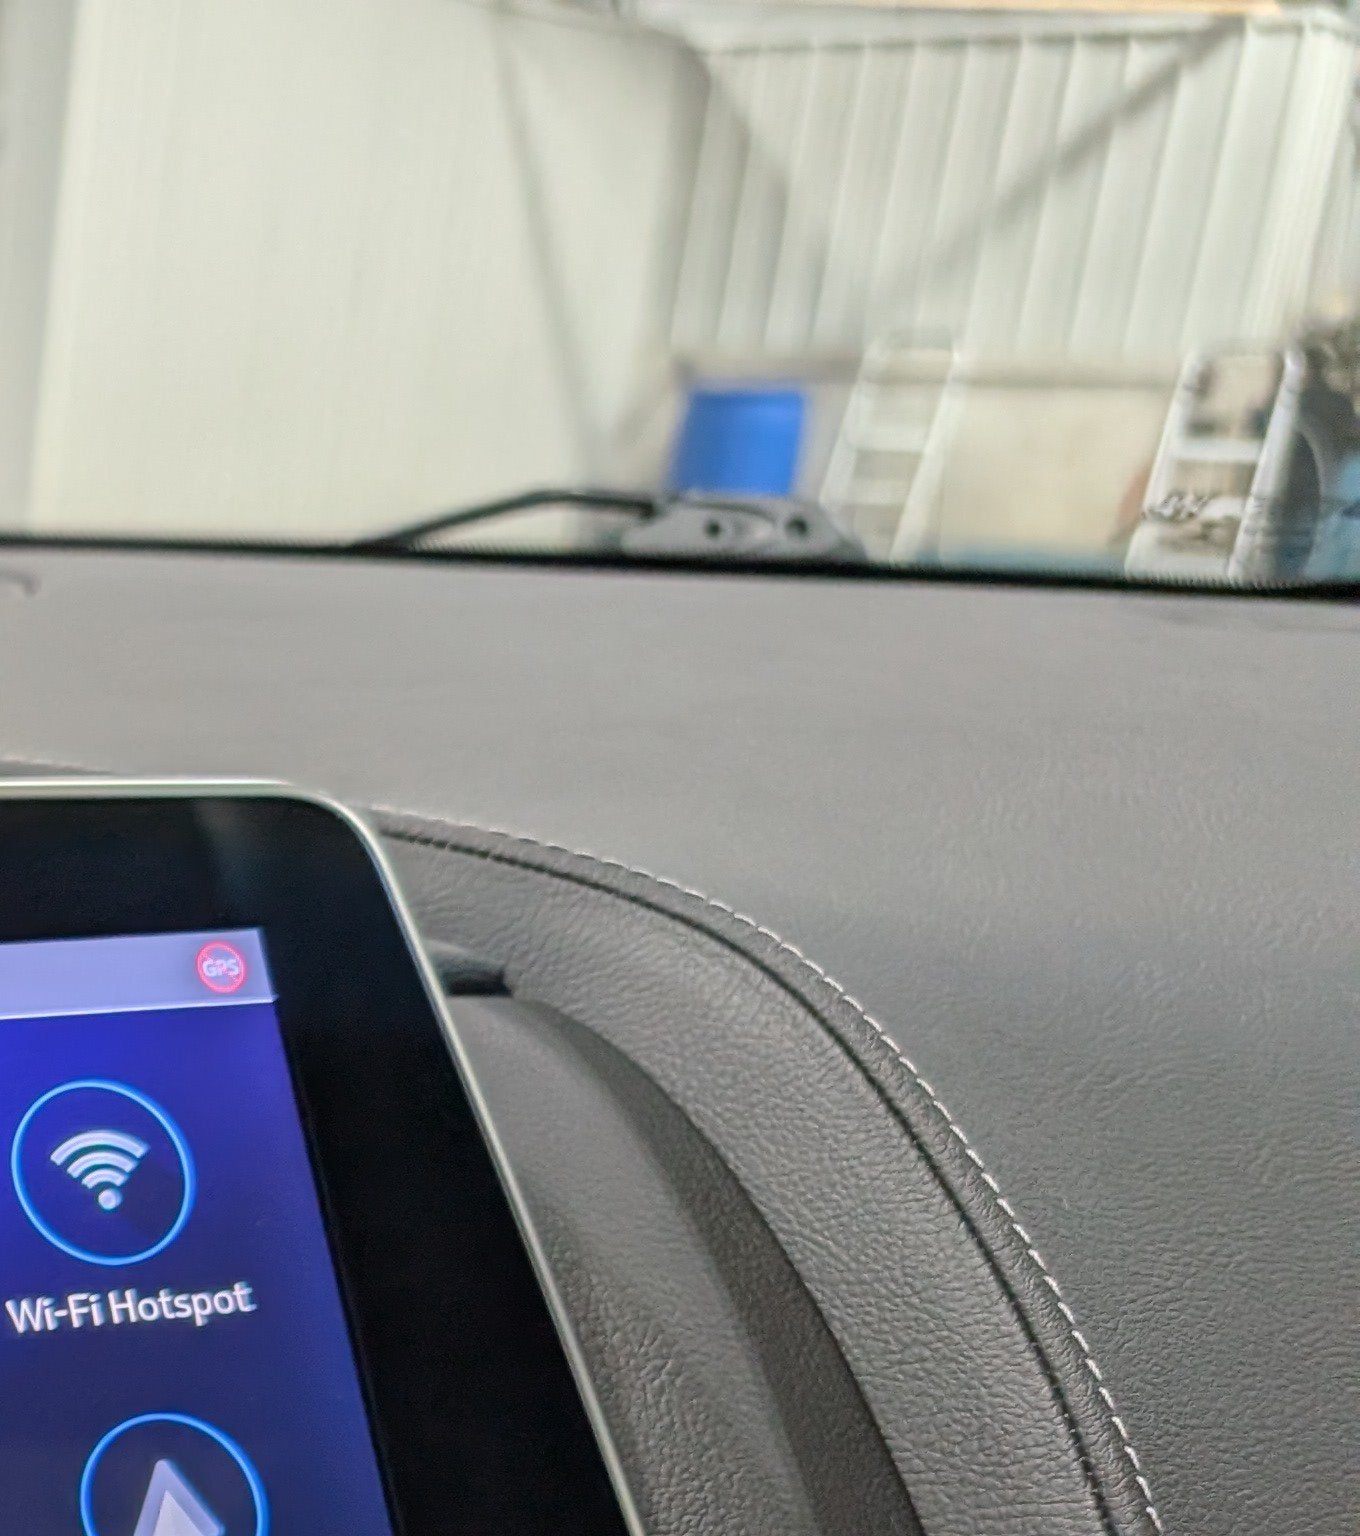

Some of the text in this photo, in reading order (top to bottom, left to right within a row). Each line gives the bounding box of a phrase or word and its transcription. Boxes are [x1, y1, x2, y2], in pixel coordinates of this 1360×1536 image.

[201, 956, 241, 978] GPS
[5, 1281, 258, 1334] Wi-Fi Hotspot
